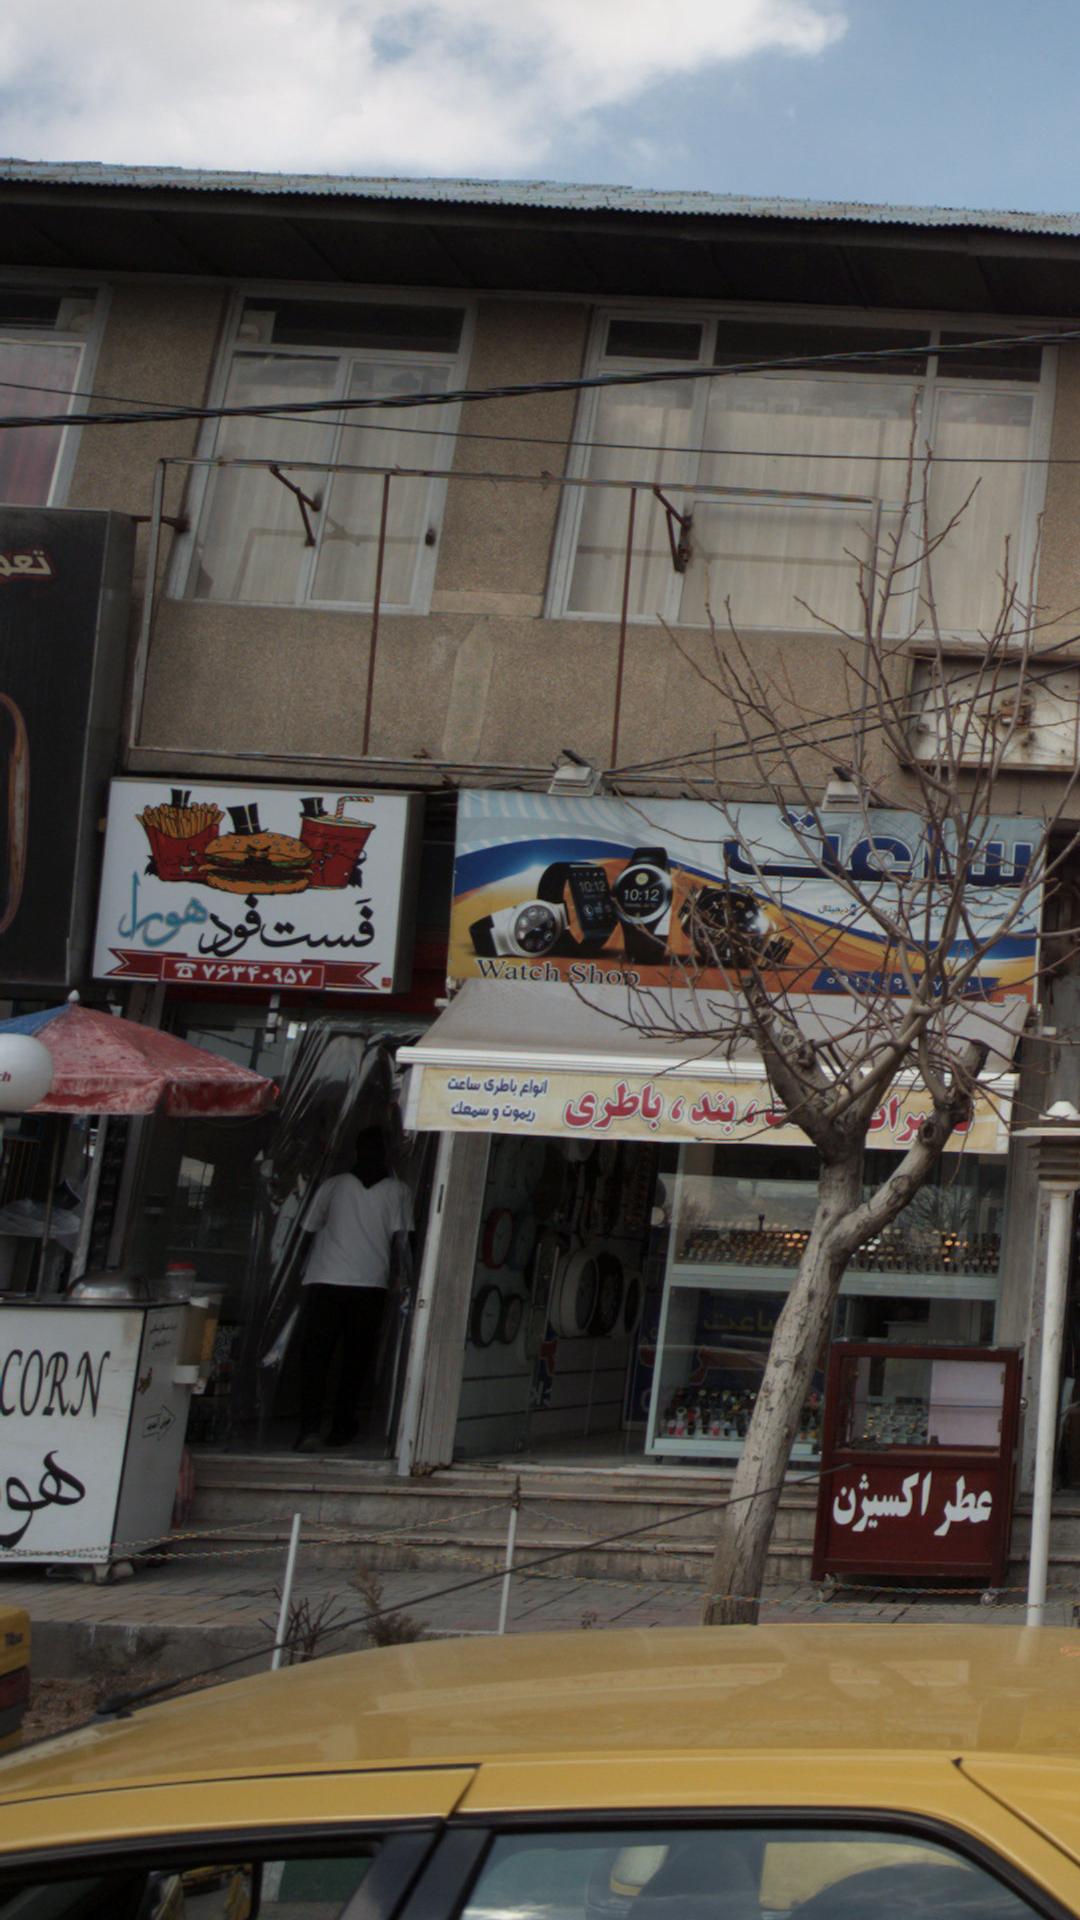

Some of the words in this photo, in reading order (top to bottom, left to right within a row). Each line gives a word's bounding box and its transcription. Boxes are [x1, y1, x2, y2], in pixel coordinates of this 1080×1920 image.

[623, 888, 660, 902] 10:12
[199, 894, 262, 957] فود
[477, 959, 560, 982] Watch
[571, 962, 639, 989] Shop
[447, 1076, 481, 1092] ساعت
[484, 1077, 517, 1097] باطری
[520, 1077, 548, 1097] انواع
[493, 1107, 499, 1121] و
[502, 1105, 536, 1122] ریموت
[565, 1082, 662, 1129] باطری
[832, 1471, 932, 1533] اکسیژن
[934, 1475, 993, 1537] عطر
